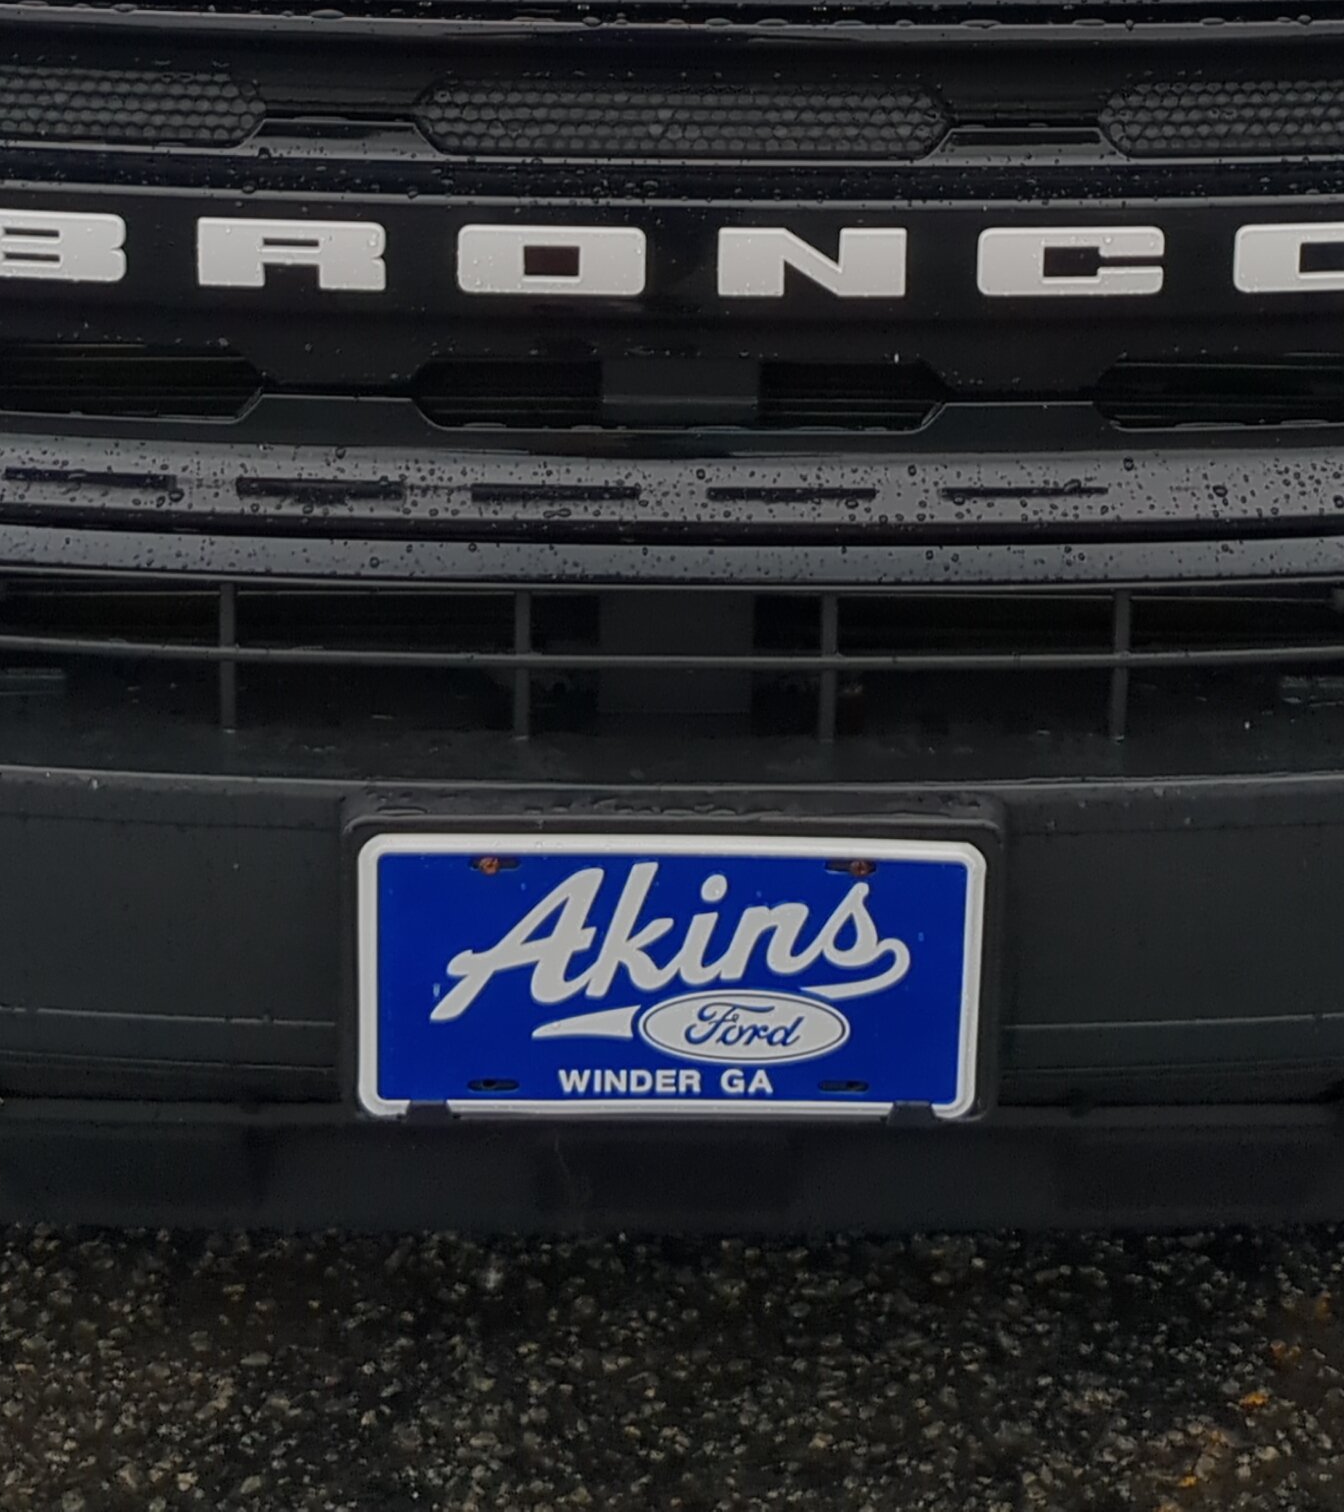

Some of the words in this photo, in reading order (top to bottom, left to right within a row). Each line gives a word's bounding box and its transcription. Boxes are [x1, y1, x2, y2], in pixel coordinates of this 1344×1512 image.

[429, 861, 912, 1023] Akins
[683, 1001, 803, 1048] Ford
[558, 1068, 702, 1094] WINDER
[720, 1068, 774, 1094] GA
